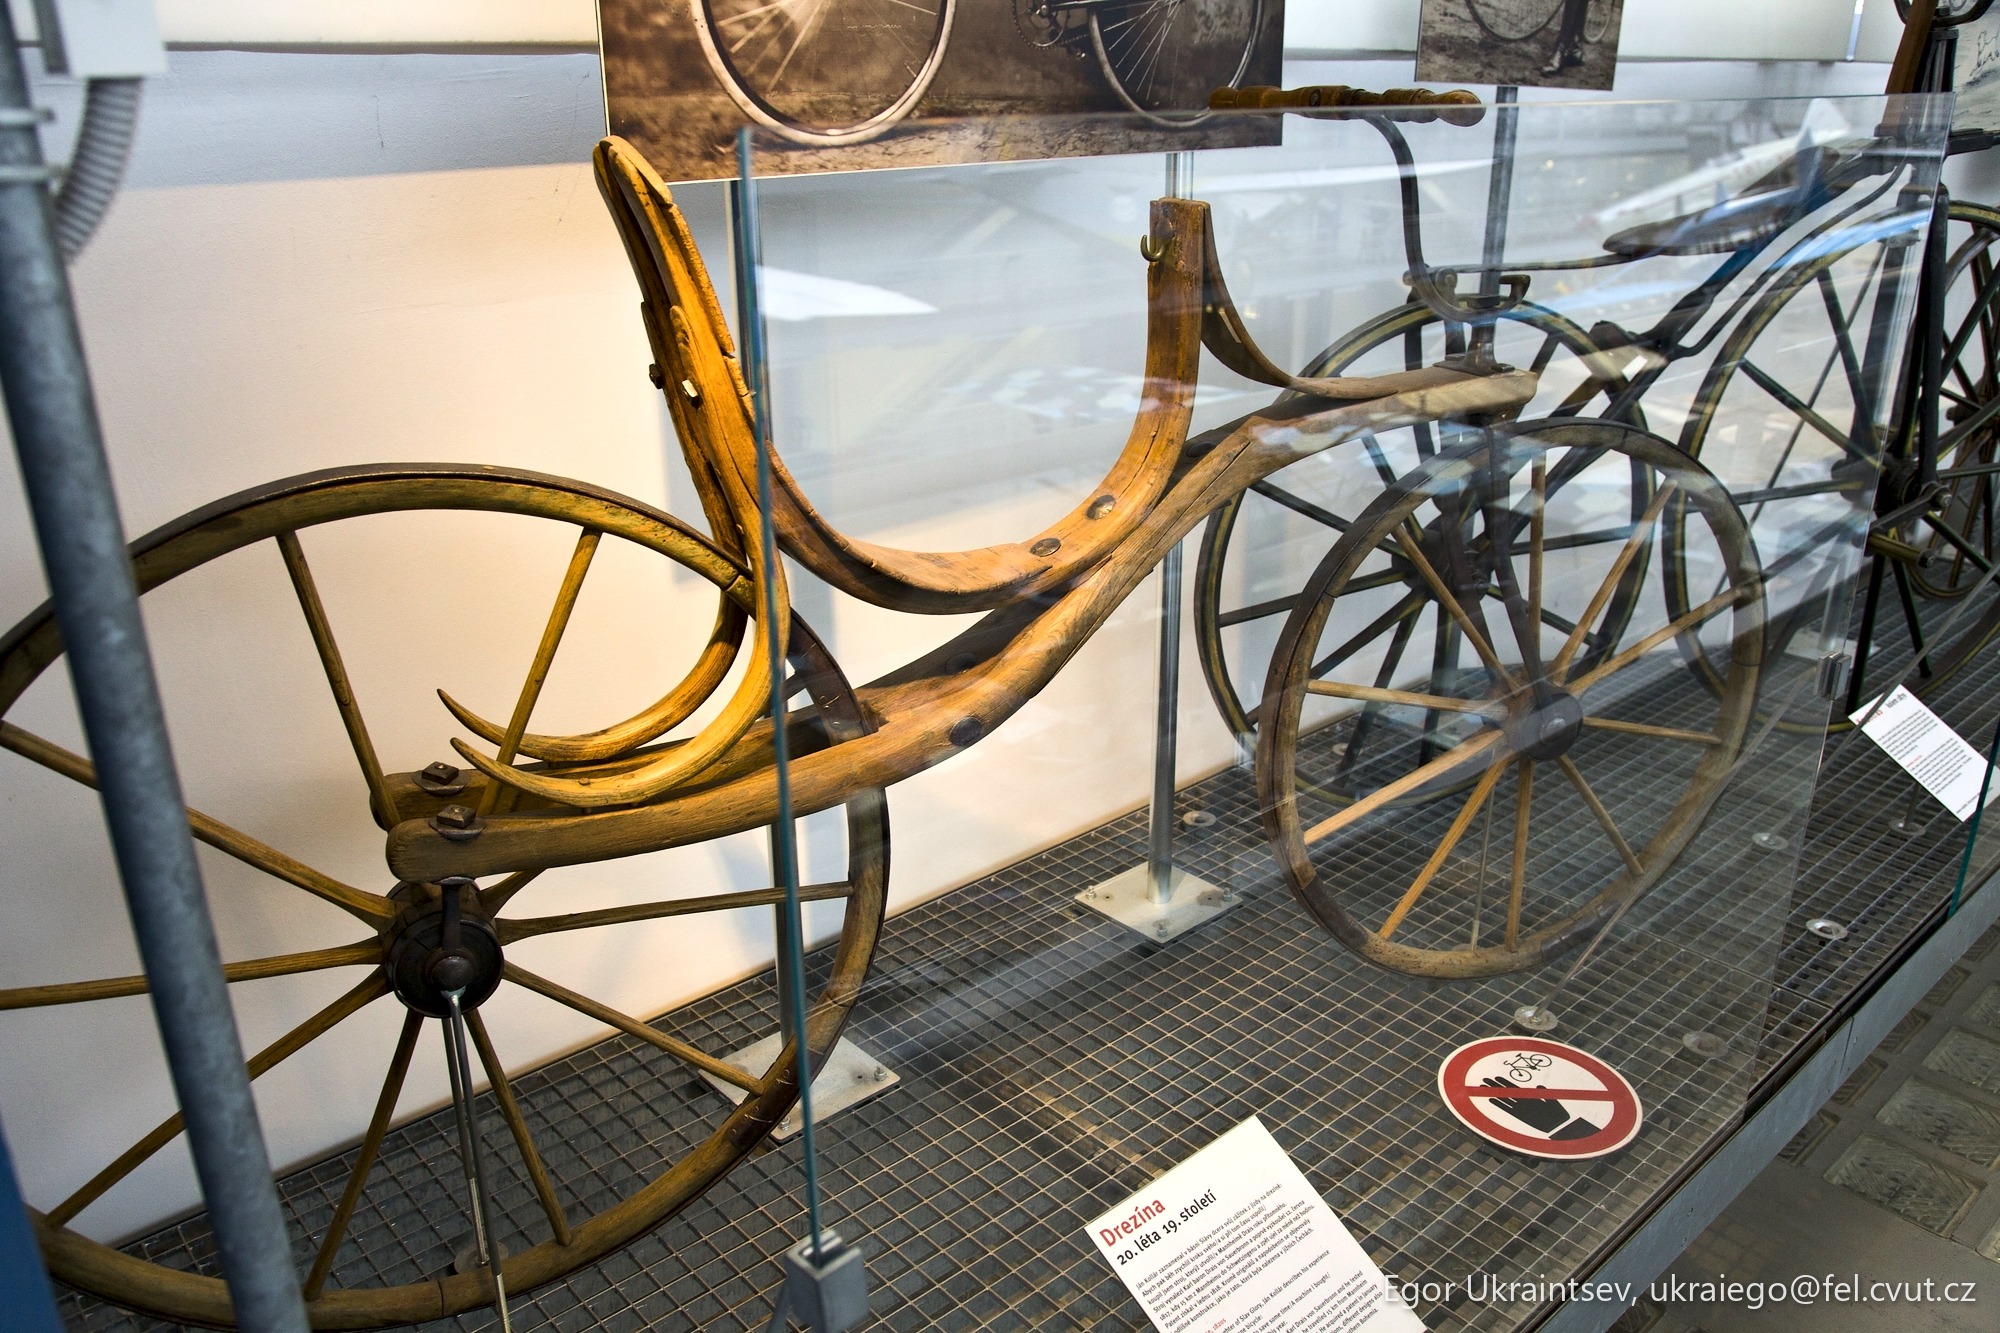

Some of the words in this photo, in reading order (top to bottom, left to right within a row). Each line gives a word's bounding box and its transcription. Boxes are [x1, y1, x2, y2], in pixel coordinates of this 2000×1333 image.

[1100, 1200, 1165, 1246] Drezína
[1117, 1250, 1138, 1265] 20.
[1134, 1231, 1161, 1251] léta
[1163, 1220, 1181, 1234] 19.
[1180, 1189, 1216, 1222] století
[1142, 1285, 1157, 1297] Abych
[1156, 1278, 1166, 1288] pak
[1164, 1272, 1175, 1281] běh
[1174, 1259, 1191, 1275] zrychlil
[1189, 1251, 1204, 1262] kroku
[1225, 1230, 1233, 1238] při
[1231, 1224, 1241, 1233] tom
[1239, 1218, 1251, 1227] času
[1249, 1204, 1267, 1220] uspořil/
[1135, 1281, 1145, 1290] Ján
[1143, 1271, 1159, 1284] Kollár
[1158, 1252, 1185, 1274] zaznamenal
[1186, 1242, 1200, 1253] básni
[1199, 1234, 1213, 1244] Slávy
[1211, 1225, 1224, 1236] dcera
[1223, 1218, 1234, 1227] svůj
[1147, 1291, 1163, 1305] koupil
[1161, 1284, 1174, 1296] jsem
[1173, 1275, 1187, 1287] stroj,
[1199, 1252, 1219, 1268] utvořil/v
[1217, 1233, 1243, 1254] Mannheimě
[1241, 1226, 1254, 1237] Drais
[1253, 1220, 1264, 1228] roku
[1153, 1301, 1167, 1313] Stroj
[1164, 1288, 1184, 1305] vynalezl
[1182, 1281, 1194, 1291] Karl
[1191, 1272, 1207, 1285] baron
[1204, 1264, 1218, 1275] Drais
[1216, 1258, 1226, 1266] von
[1224, 1241, 1250, 1261] Sauerbronn
[1252, 1227, 1267, 1242] poprvé
[1266, 1213, 1287, 1230] vyzkoušel
[1290, 1200, 1305, 1212] června
[1159, 1311, 1173, 1321] 1817,
[1170, 1304, 1181, 1312] kdy
[1184, 1294, 1194, 1302] km
[1195, 1274, 1222, 1294] Mannheimu
[1226, 1247, 1258, 1271] Schwetzingenu
[1260, 1237, 1270, 1247] zpět
[1269, 1230, 1278, 1240] ujel
[1281, 1218, 1293, 1230] méně
[1292, 1213, 1301, 1222] než
[1164, 1315, 1181, 1329] Patent
[1196, 1293, 1211, 1305] lednu
[1210, 1284, 1223, 1296] 1818.
[1221, 1273, 1237, 1286] Kromě
[1236, 1259, 1256, 1276] originálů
[1257, 1238, 1285, 1260] napodobenin
[1289, 1219, 1311, 1236] objevovaly
[1189, 1302, 1217, 1322] konstrukce,
[1214, 1294, 1227, 1305] jako
[1229, 1283, 1242, 1292] tato,
[1239, 1273, 1253, 1284] která
[1251, 1266, 1263, 1276] byla
[1261, 1252, 1281, 1269] nalezena
[1294, 1228, 1314, 1243] Čechách.
[1234, 1318, 1241, 1326] of
[1239, 1312, 1250, 1322] Slav
[1249, 1303, 1264, 1314] Glory,
[1262, 1296, 1271, 1305] Ján
[1269, 1286, 1283, 1298] Kollár
[1282, 1271, 1303, 1289] describes
[1308, 1250, 1330, 1268] experience
[1258, 1322, 1270, 1333] save
[1268, 1312, 1281, 1324] some
[1279, 1300, 1296, 1315] time/A
[1294, 1288, 1312, 1303] machine
[1312, 1272, 1331, 1288] bought/
[1294, 1316, 1308, 1328] Drais
[1306, 1310, 1315, 1319] von
[1313, 1292, 1338, 1313] Sauerbronn
[1337, 1284, 1346, 1294] and
[1349, 1270, 1363, 1283] tested
[1307, 1312, 1327, 1330] travelled
[1330, 1303, 1339, 1311] km
[1336, 1295, 1348, 1305] from
[1346, 1279, 1368, 1298] Mannheim
[1325, 1311, 1344, 1328] acquired
[1345, 1298, 1360, 1313] patent
[1361, 1284, 1378, 1298] January
[1342, 1310, 1360, 1327] different
[1358, 1298, 1375, 1313] designs
[1373, 1291, 1383, 1300] also
[1359, 1308, 1379, 1325] Bohemia.
[1212, 1318, 1227, 1331] 1820s
[1244, 1314, 1264, 1330] bicycle:
[1275, 1320, 1288, 1332] year.
